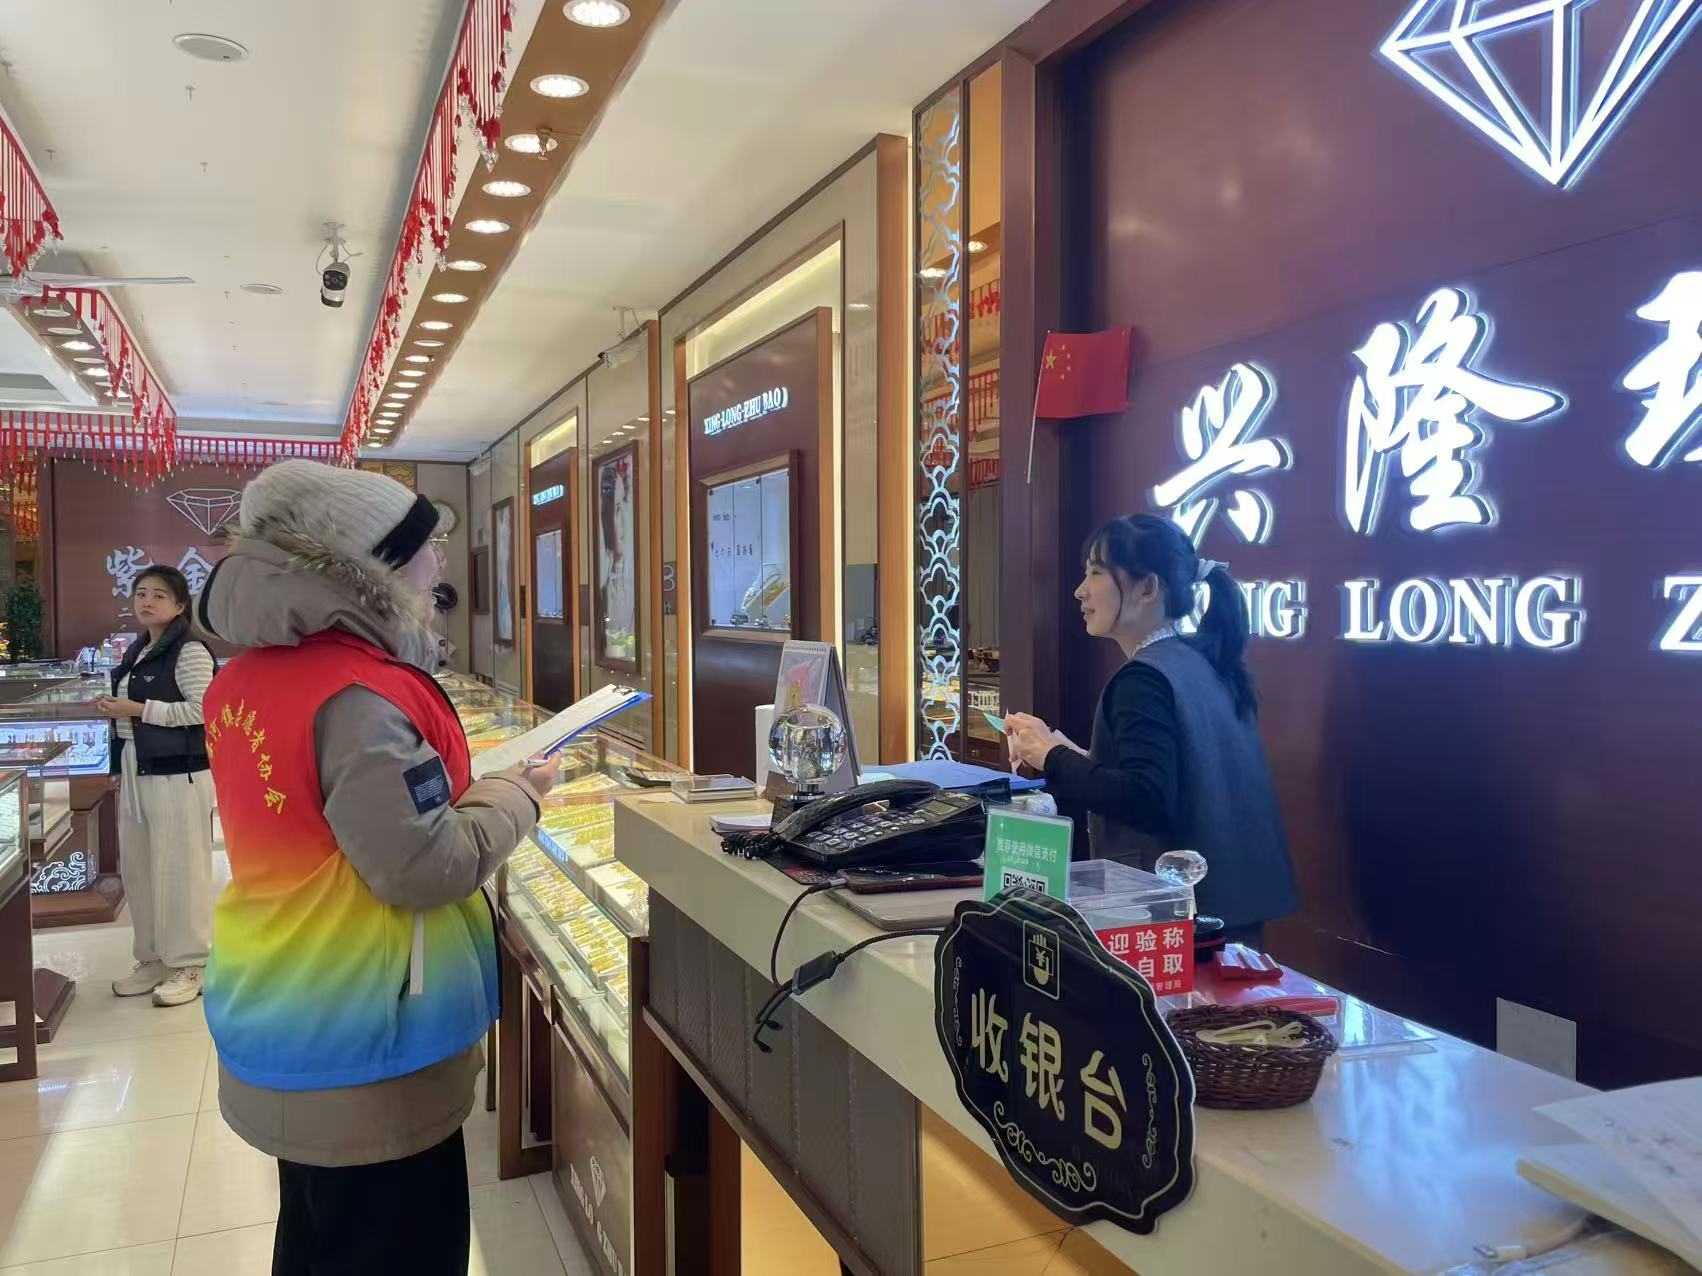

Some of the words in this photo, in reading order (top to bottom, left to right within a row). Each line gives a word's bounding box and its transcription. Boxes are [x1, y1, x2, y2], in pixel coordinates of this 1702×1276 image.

[762, 387, 781, 411] BAO
[1343, 577, 1582, 648] LONG
[1124, 954, 1184, 979] 自取
[971, 987, 1127, 1150] 收银台
